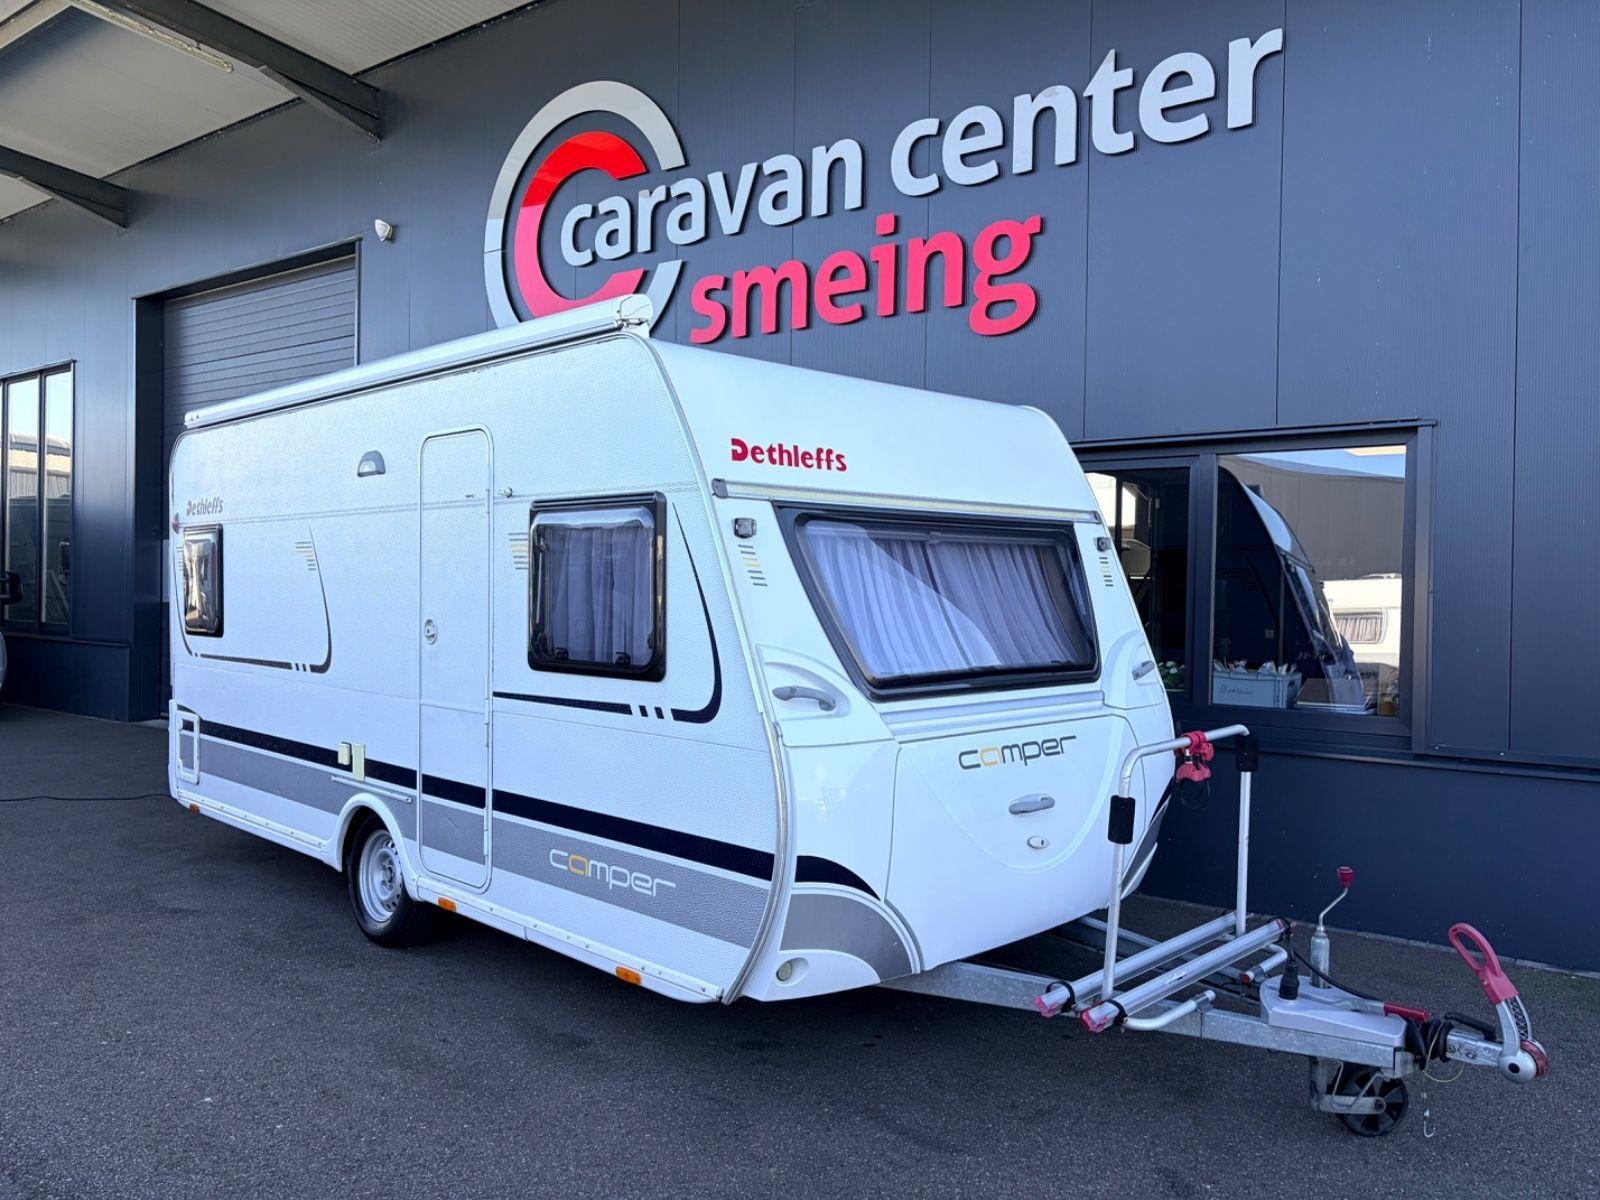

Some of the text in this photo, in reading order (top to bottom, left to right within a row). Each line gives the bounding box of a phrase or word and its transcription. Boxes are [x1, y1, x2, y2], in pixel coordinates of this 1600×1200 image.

[561, 28, 1284, 267] caravan center
[690, 213, 1044, 343] smeing
[731, 438, 847, 472] Dethleffs
[186, 496, 223, 516] Dethleffs
[959, 735, 1077, 769] camper
[549, 849, 676, 897] camper
